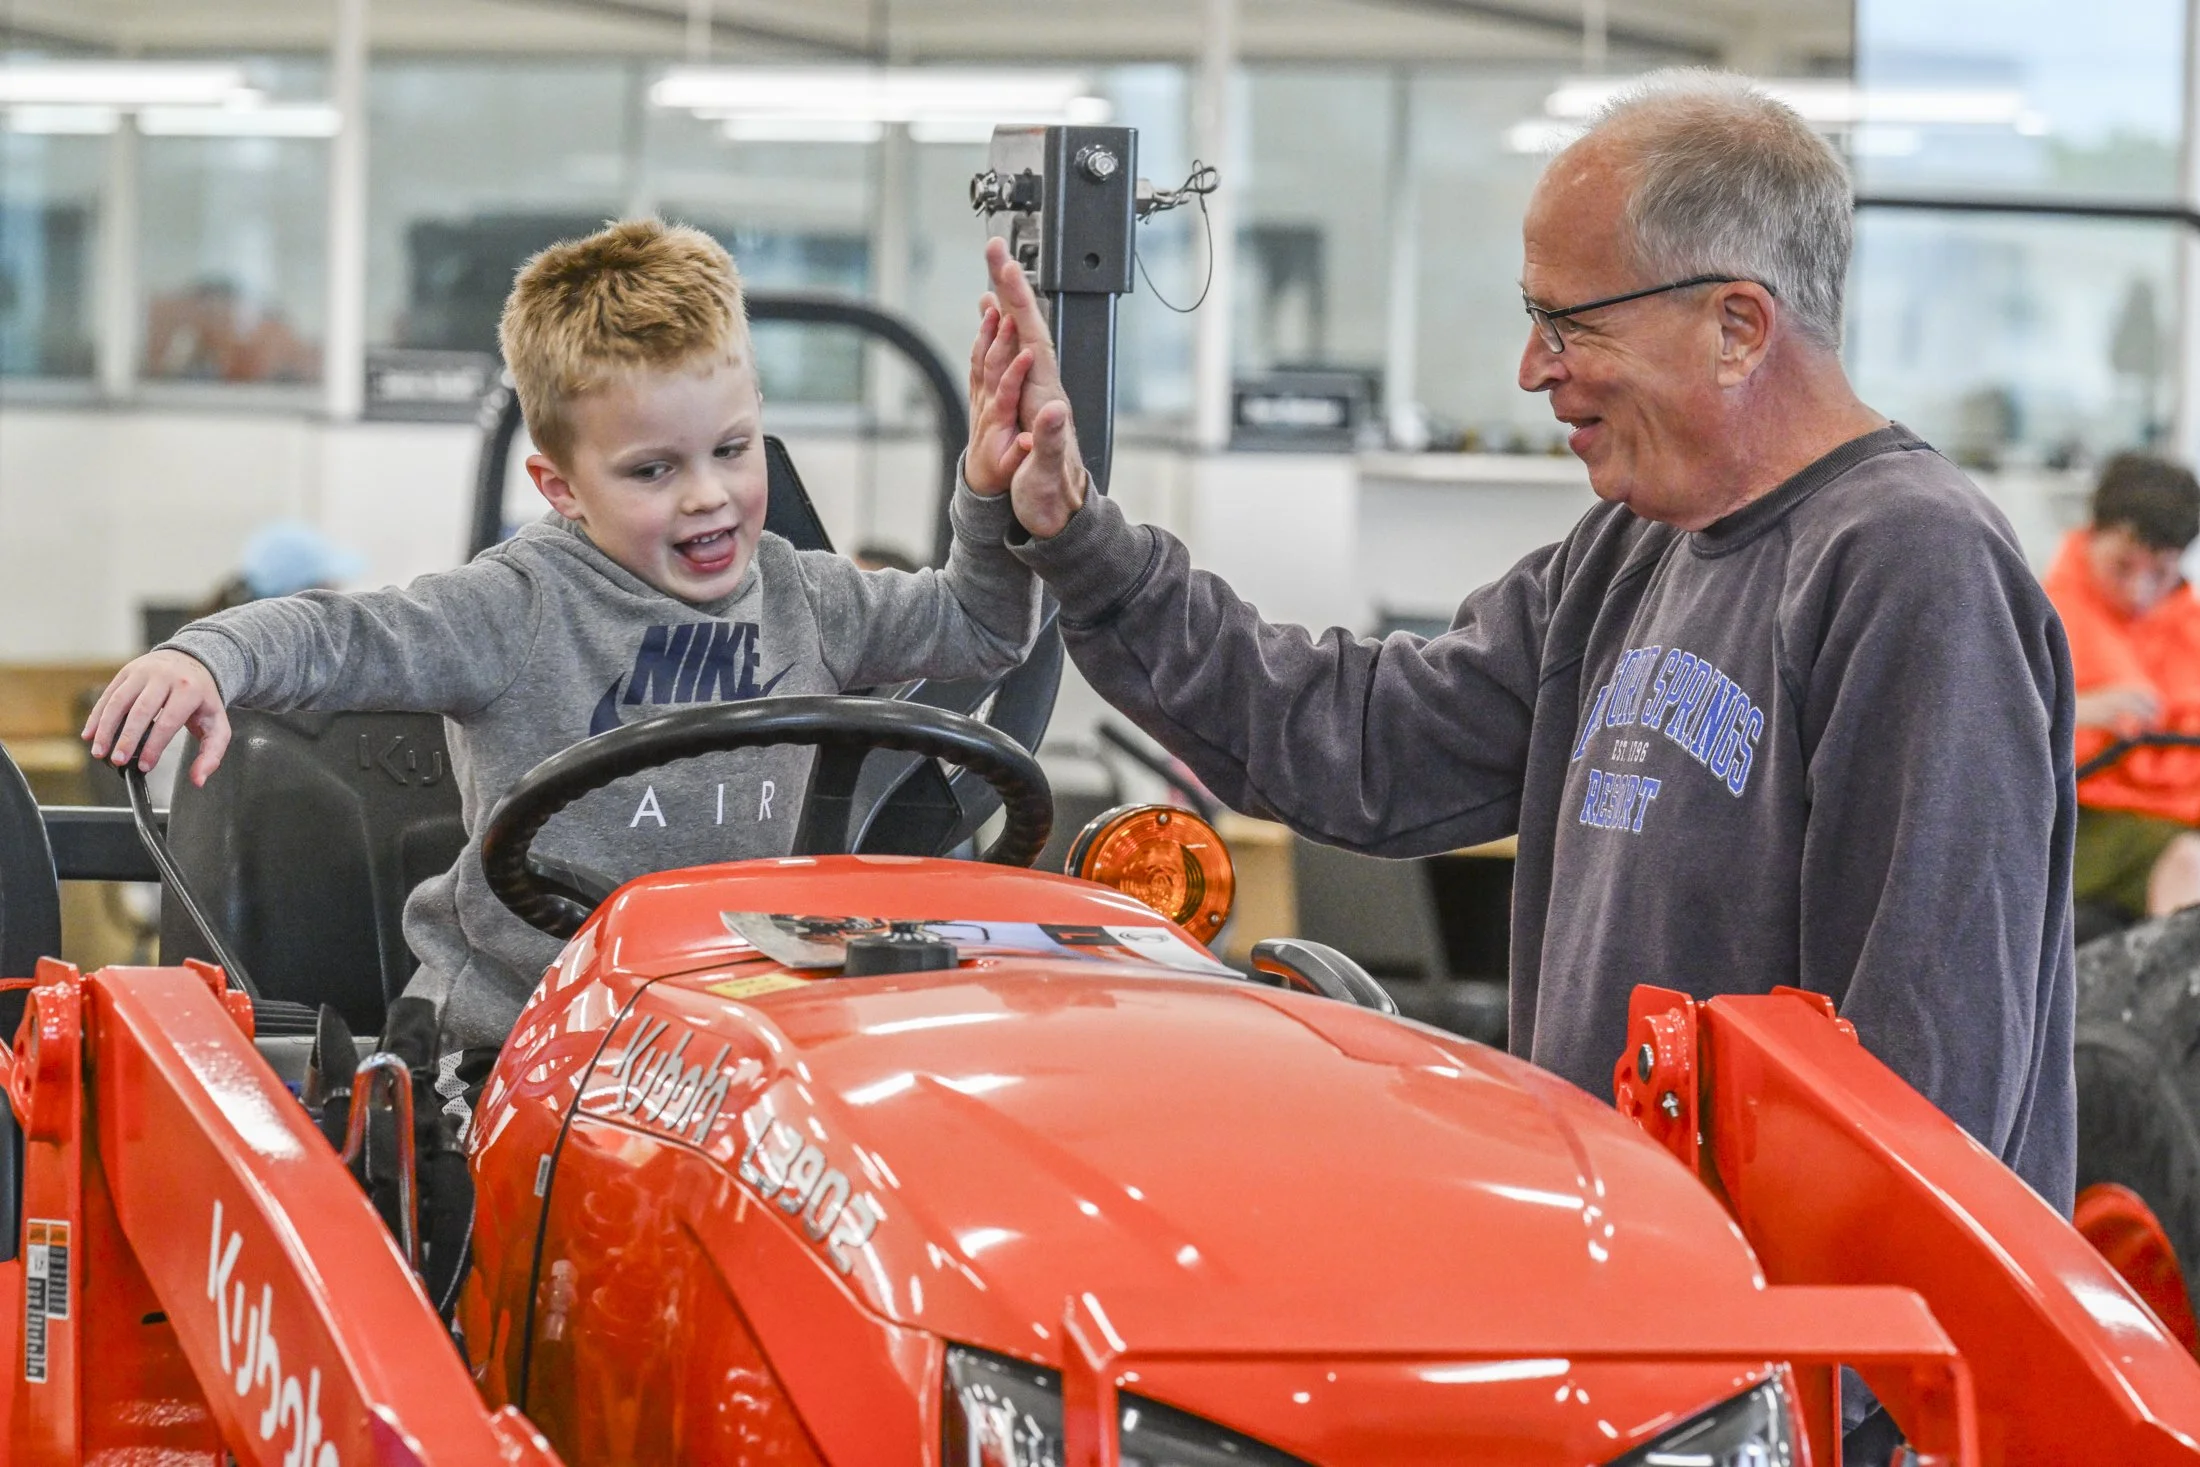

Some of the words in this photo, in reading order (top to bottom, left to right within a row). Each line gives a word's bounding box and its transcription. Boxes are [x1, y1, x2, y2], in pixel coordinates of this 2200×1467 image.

[623, 621, 761, 705] NIKE
[1641, 648, 1764, 798] SPRINGS
[629, 780, 775, 828] AIR
[612, 1015, 732, 1144] Kubota
[207, 1198, 340, 1467] Kubot
